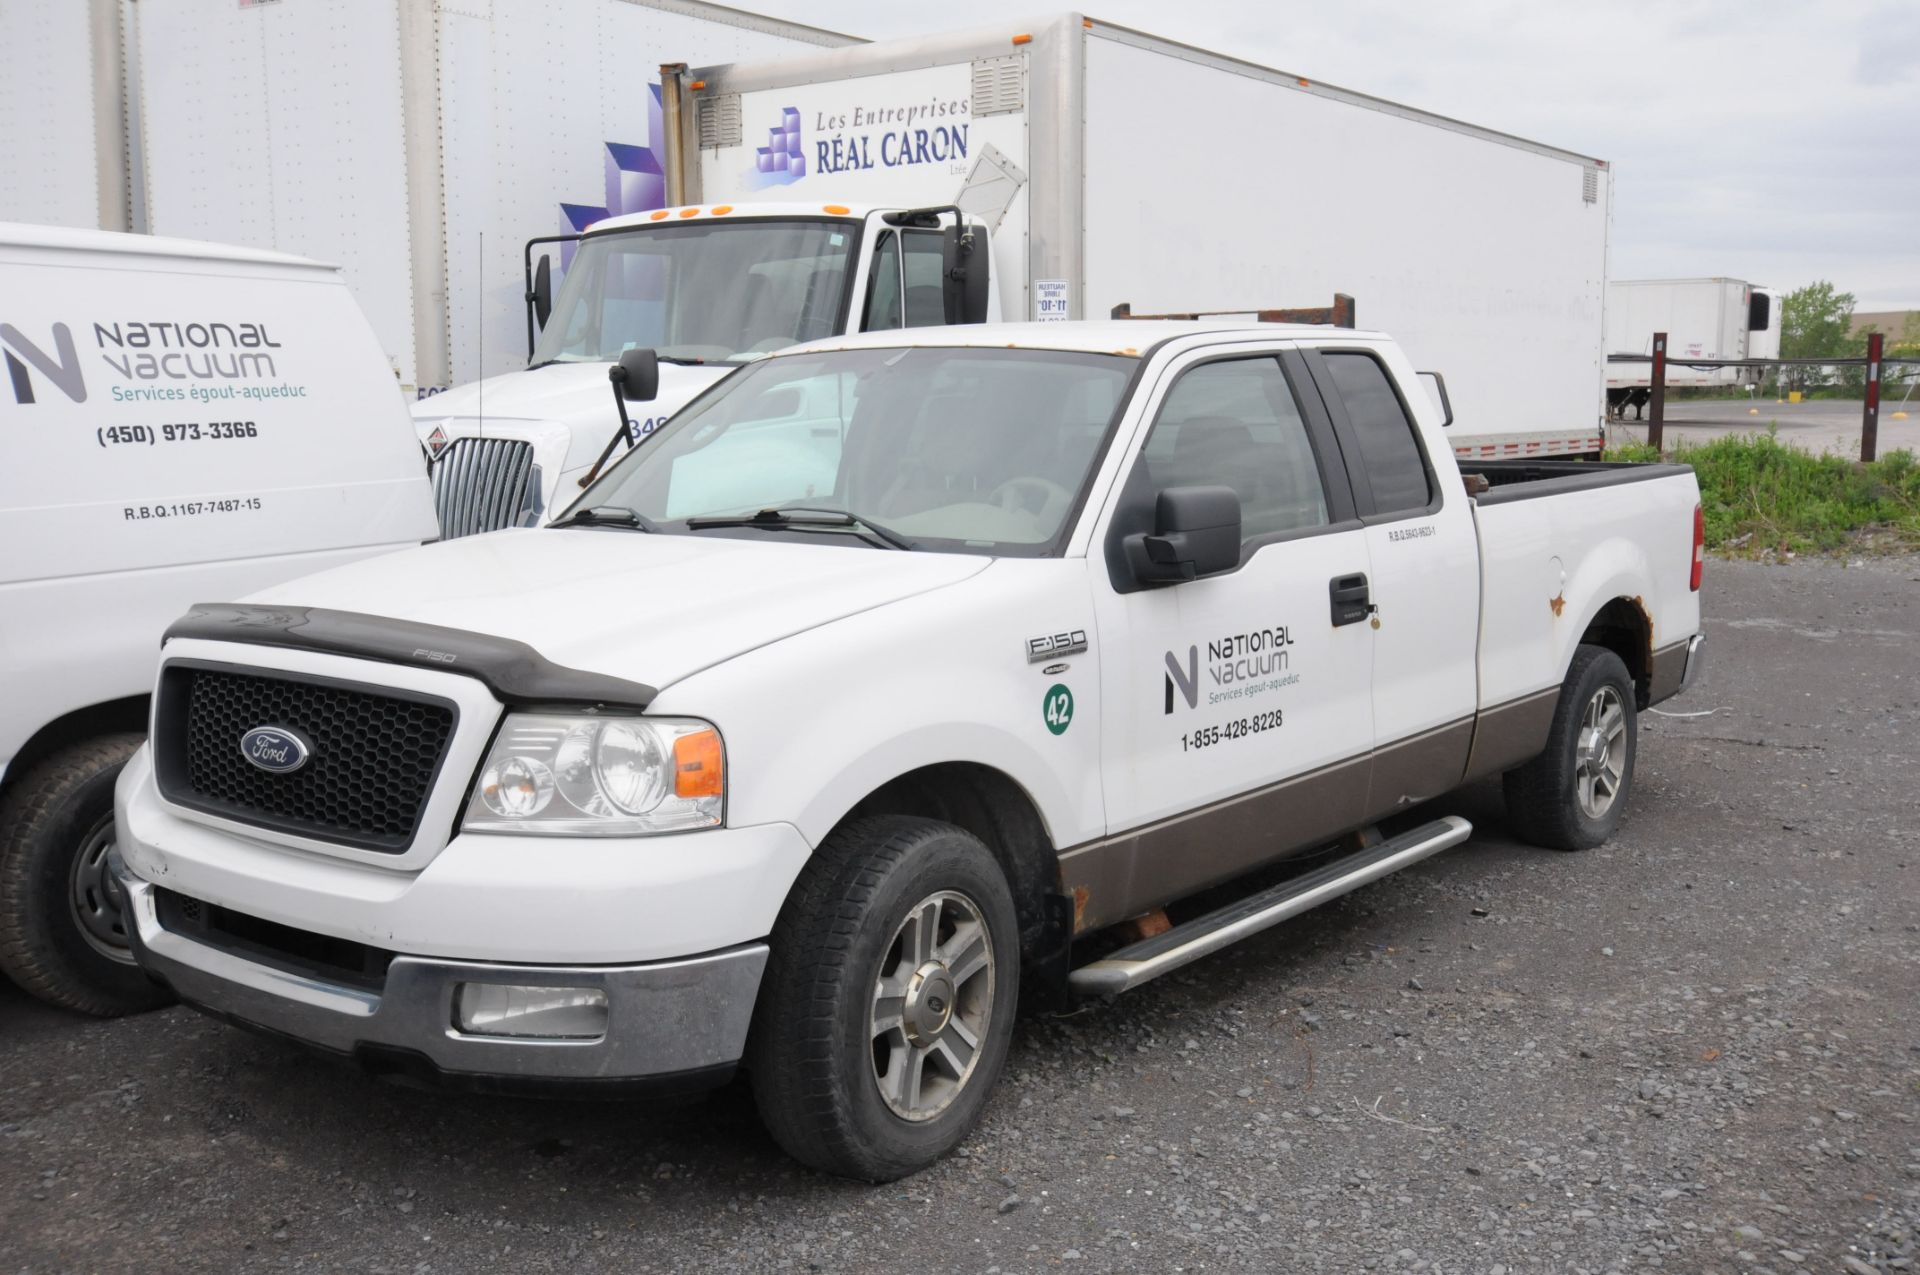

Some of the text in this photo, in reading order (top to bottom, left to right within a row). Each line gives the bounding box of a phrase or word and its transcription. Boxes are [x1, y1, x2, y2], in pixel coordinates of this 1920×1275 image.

[816, 97, 969, 131] Les Entreprises
[816, 124, 969, 174] RÉAL CARON
[111, 382, 307, 403] Services égout-aqueduc
[97, 421, 258, 448] (450) 973-3366
[1047, 693, 1069, 726] 42
[1209, 687, 1242, 705] Services
[1181, 709, 1283, 752] 1-855-428-8228
[252, 734, 289, 763] Ford
